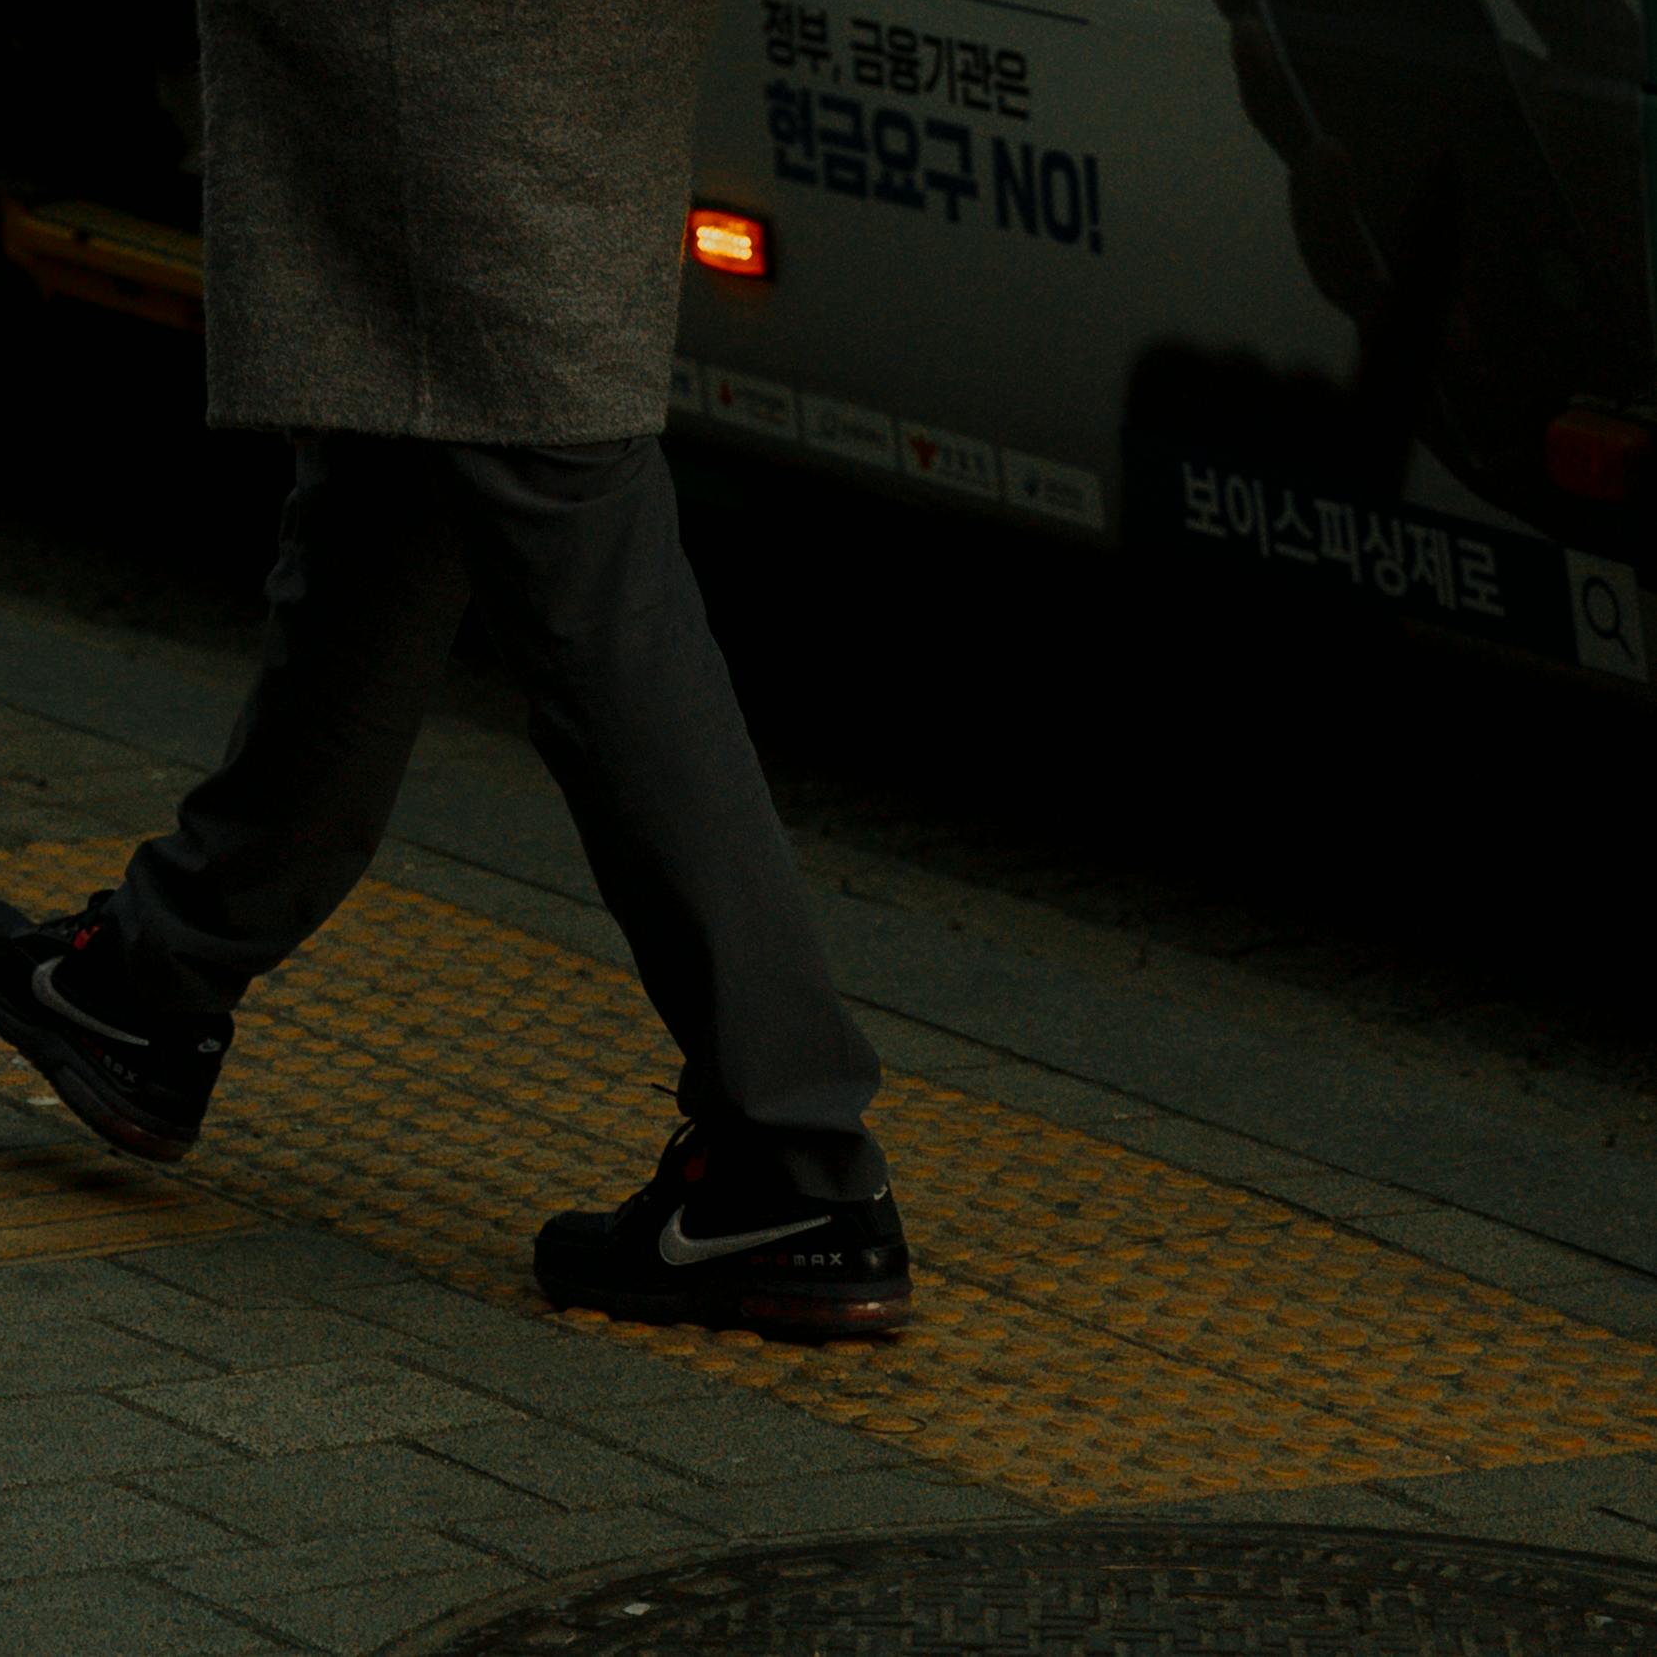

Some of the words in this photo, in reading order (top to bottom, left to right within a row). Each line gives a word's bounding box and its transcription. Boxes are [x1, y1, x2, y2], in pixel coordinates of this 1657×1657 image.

[851, 18, 1029, 120] 금융기관은
[768, 79, 978, 222] 현금요구
[993, 136, 1103, 254] NO!
[1181, 460, 1509, 620] 보이스피싱제로
